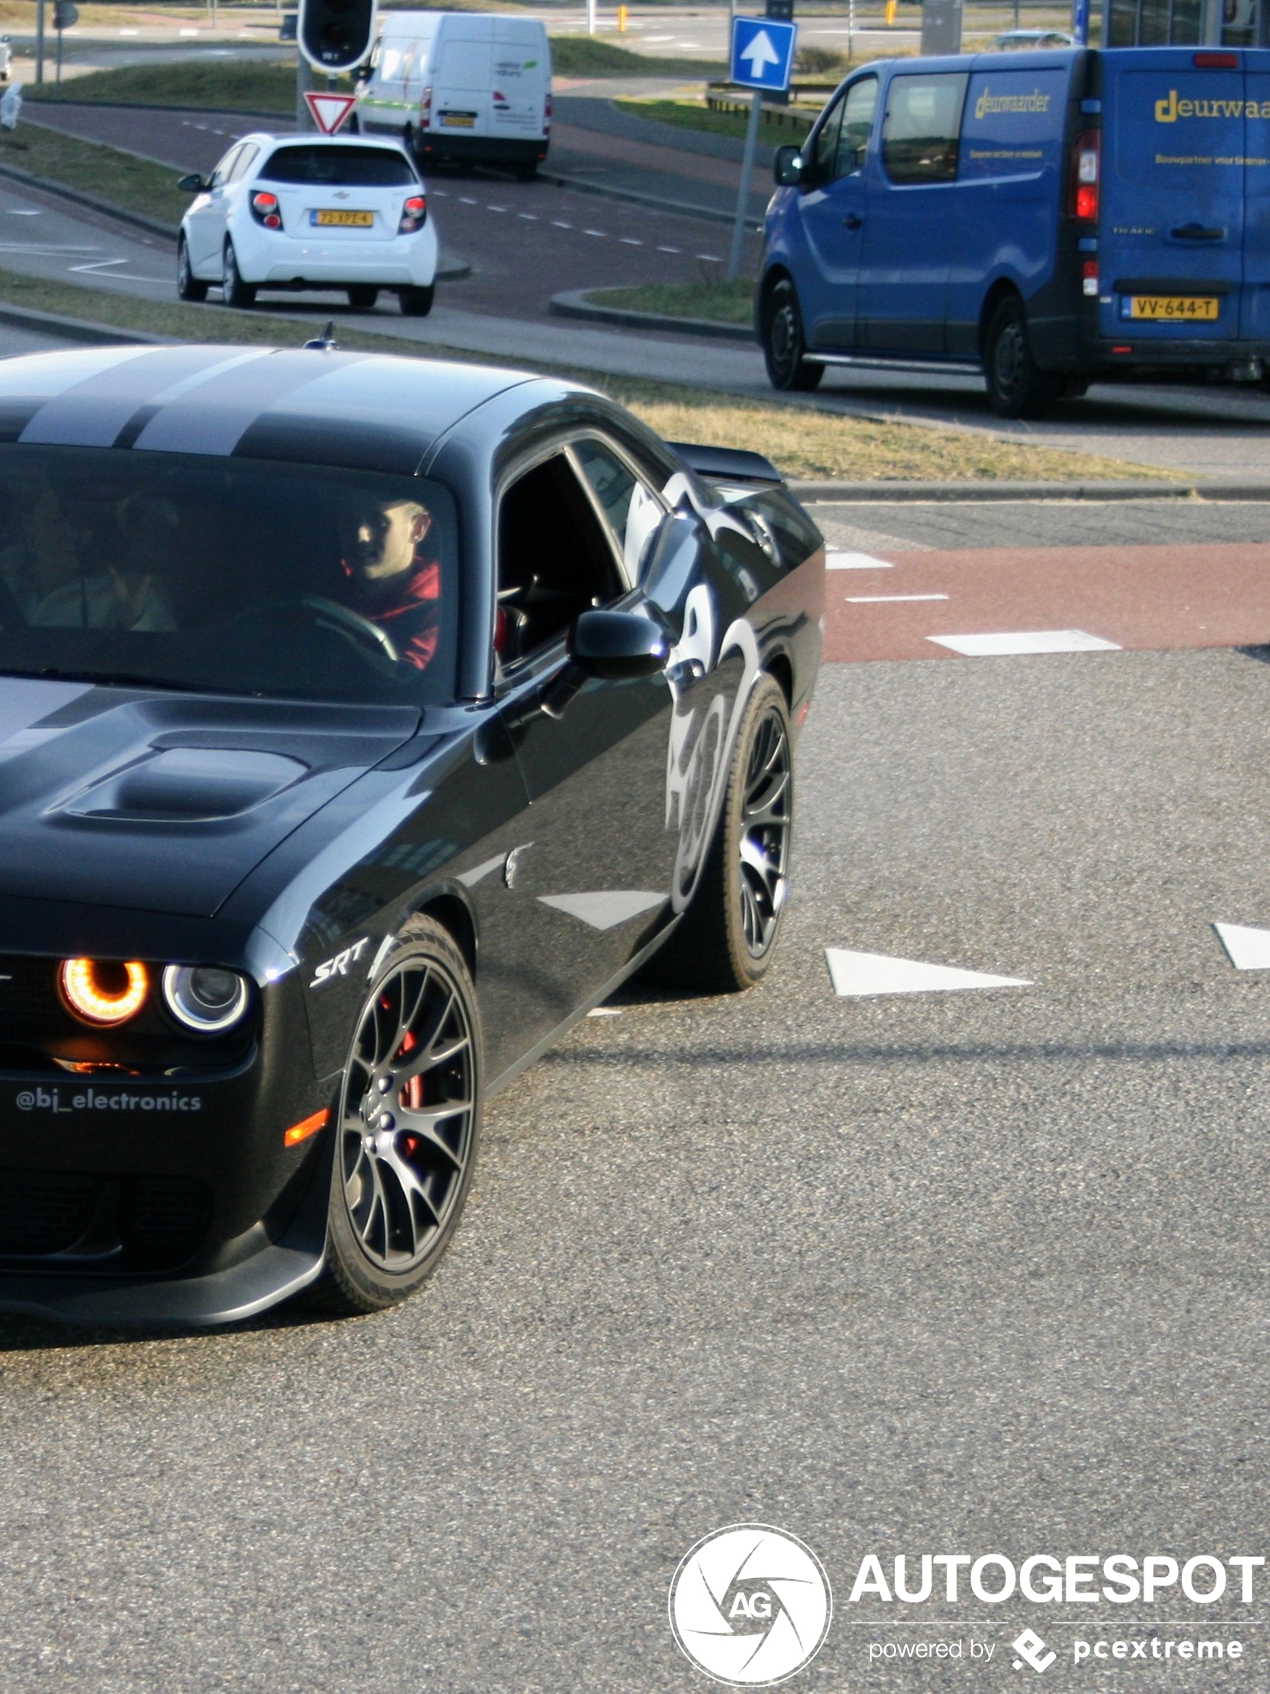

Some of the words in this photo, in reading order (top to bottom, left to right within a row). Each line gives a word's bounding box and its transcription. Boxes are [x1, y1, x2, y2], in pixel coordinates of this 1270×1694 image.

[975, 87, 1050, 119] deurwaarder
[321, 214, 368, 224] 72-XPZ-4
[1137, 300, 1212, 316] VV-644-T
[309, 936, 369, 989] SRT
[16, 1087, 202, 1113] @bj_electronics
